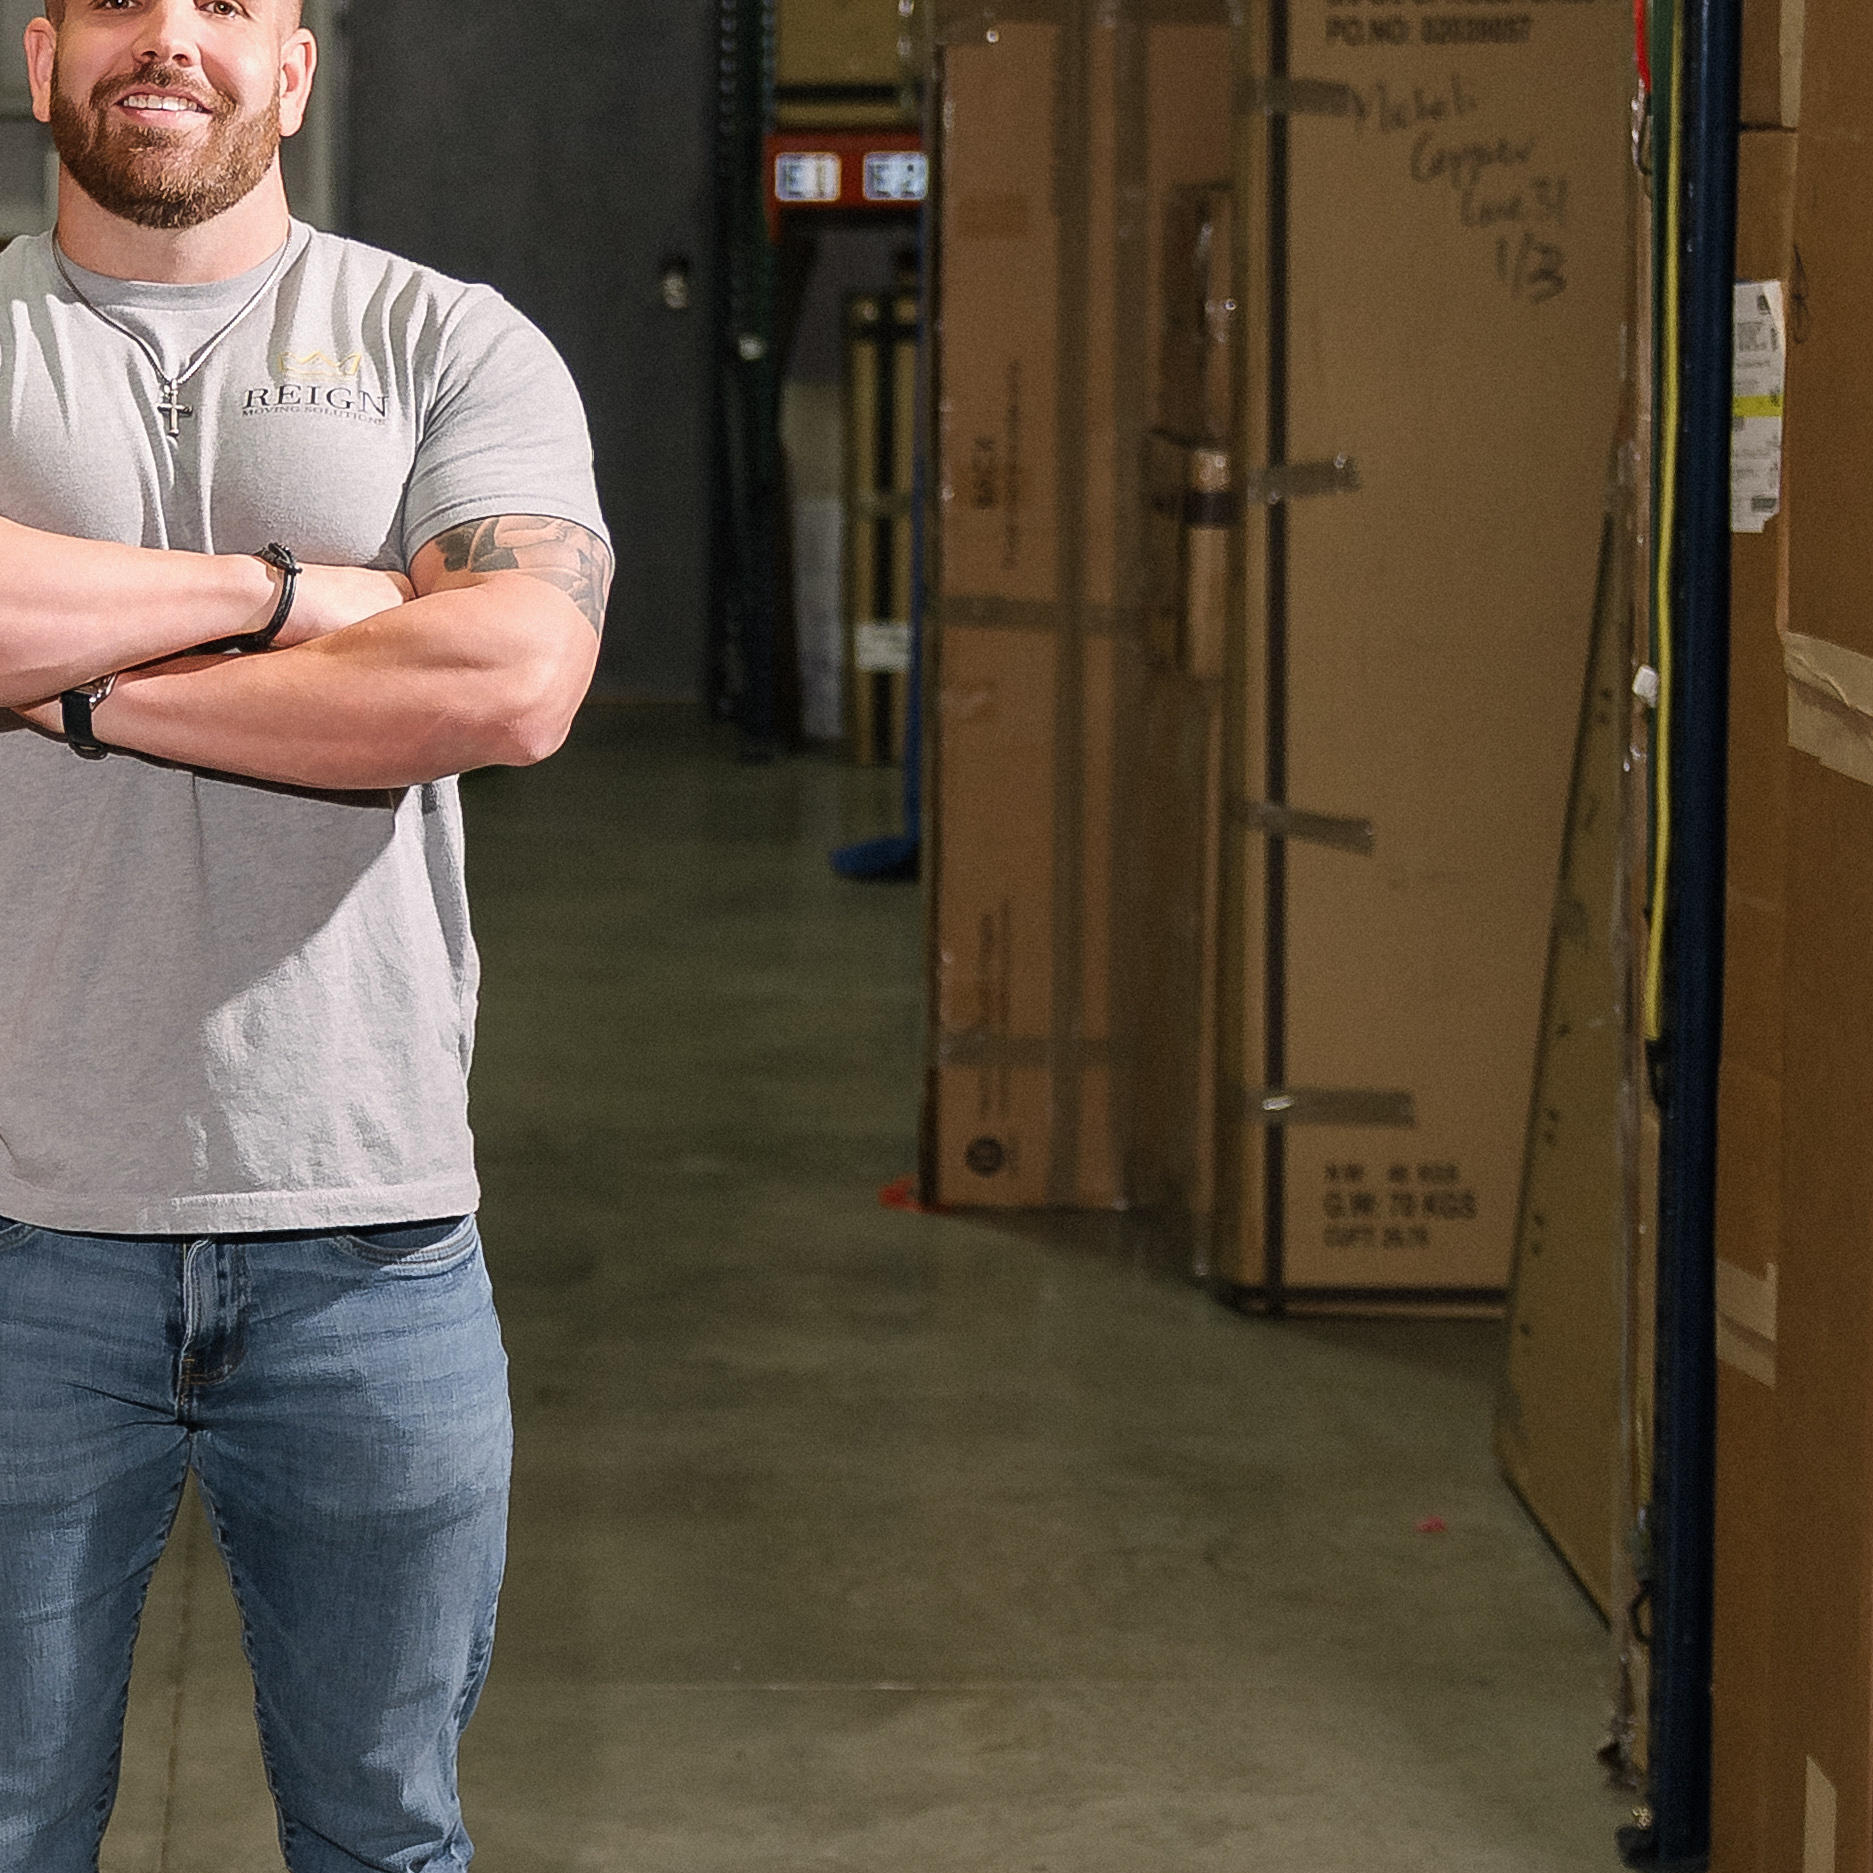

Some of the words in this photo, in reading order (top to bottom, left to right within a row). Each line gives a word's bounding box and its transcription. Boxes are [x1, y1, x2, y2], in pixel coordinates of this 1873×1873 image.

[242, 383, 390, 418] REIGN
[241, 405, 301, 418] MOVING
[303, 406, 387, 427] SOLUTIONS
